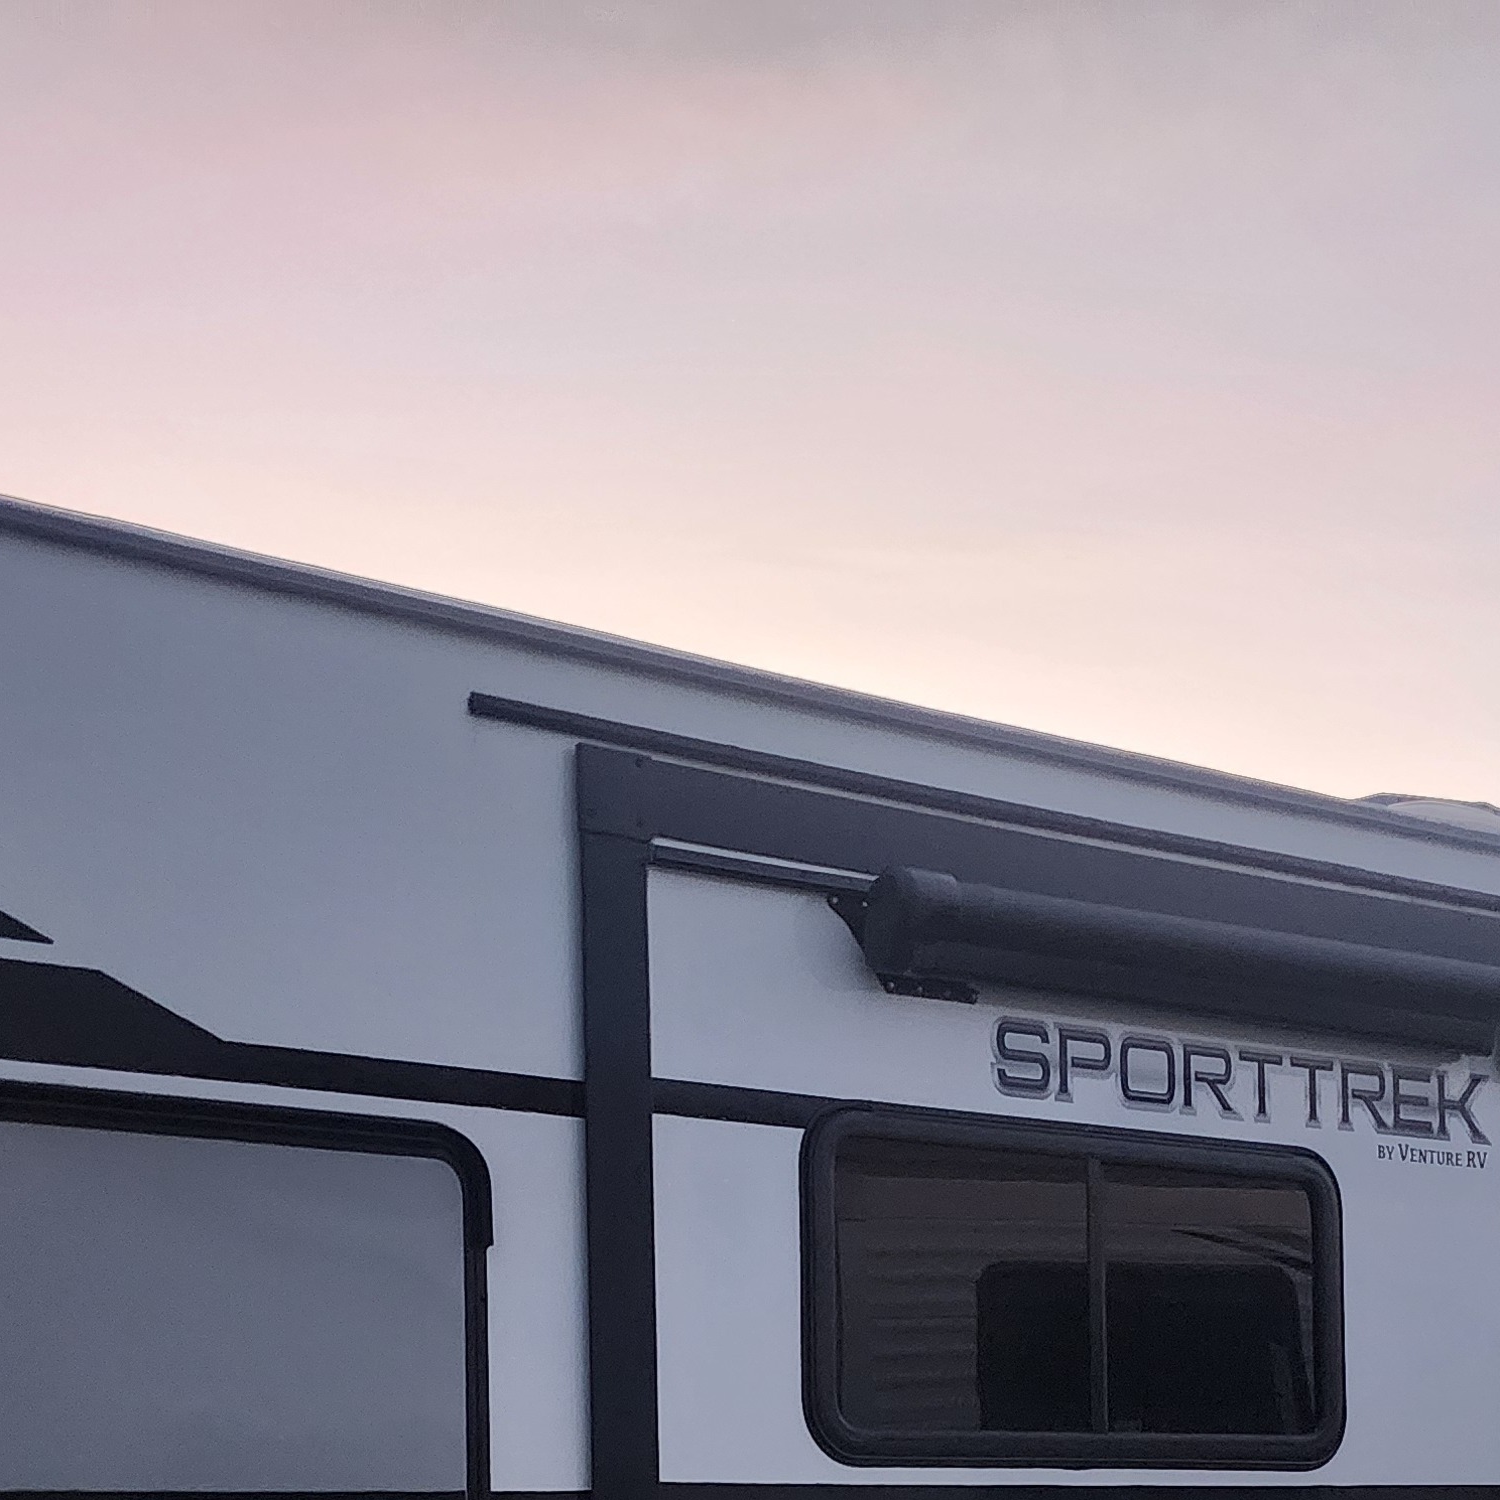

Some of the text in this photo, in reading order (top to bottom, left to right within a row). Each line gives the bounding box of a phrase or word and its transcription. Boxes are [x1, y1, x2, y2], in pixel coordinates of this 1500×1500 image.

[992, 1015, 1491, 1145] SPORTTREK
[1377, 1143, 1487, 1168] BY VENTURE RV
